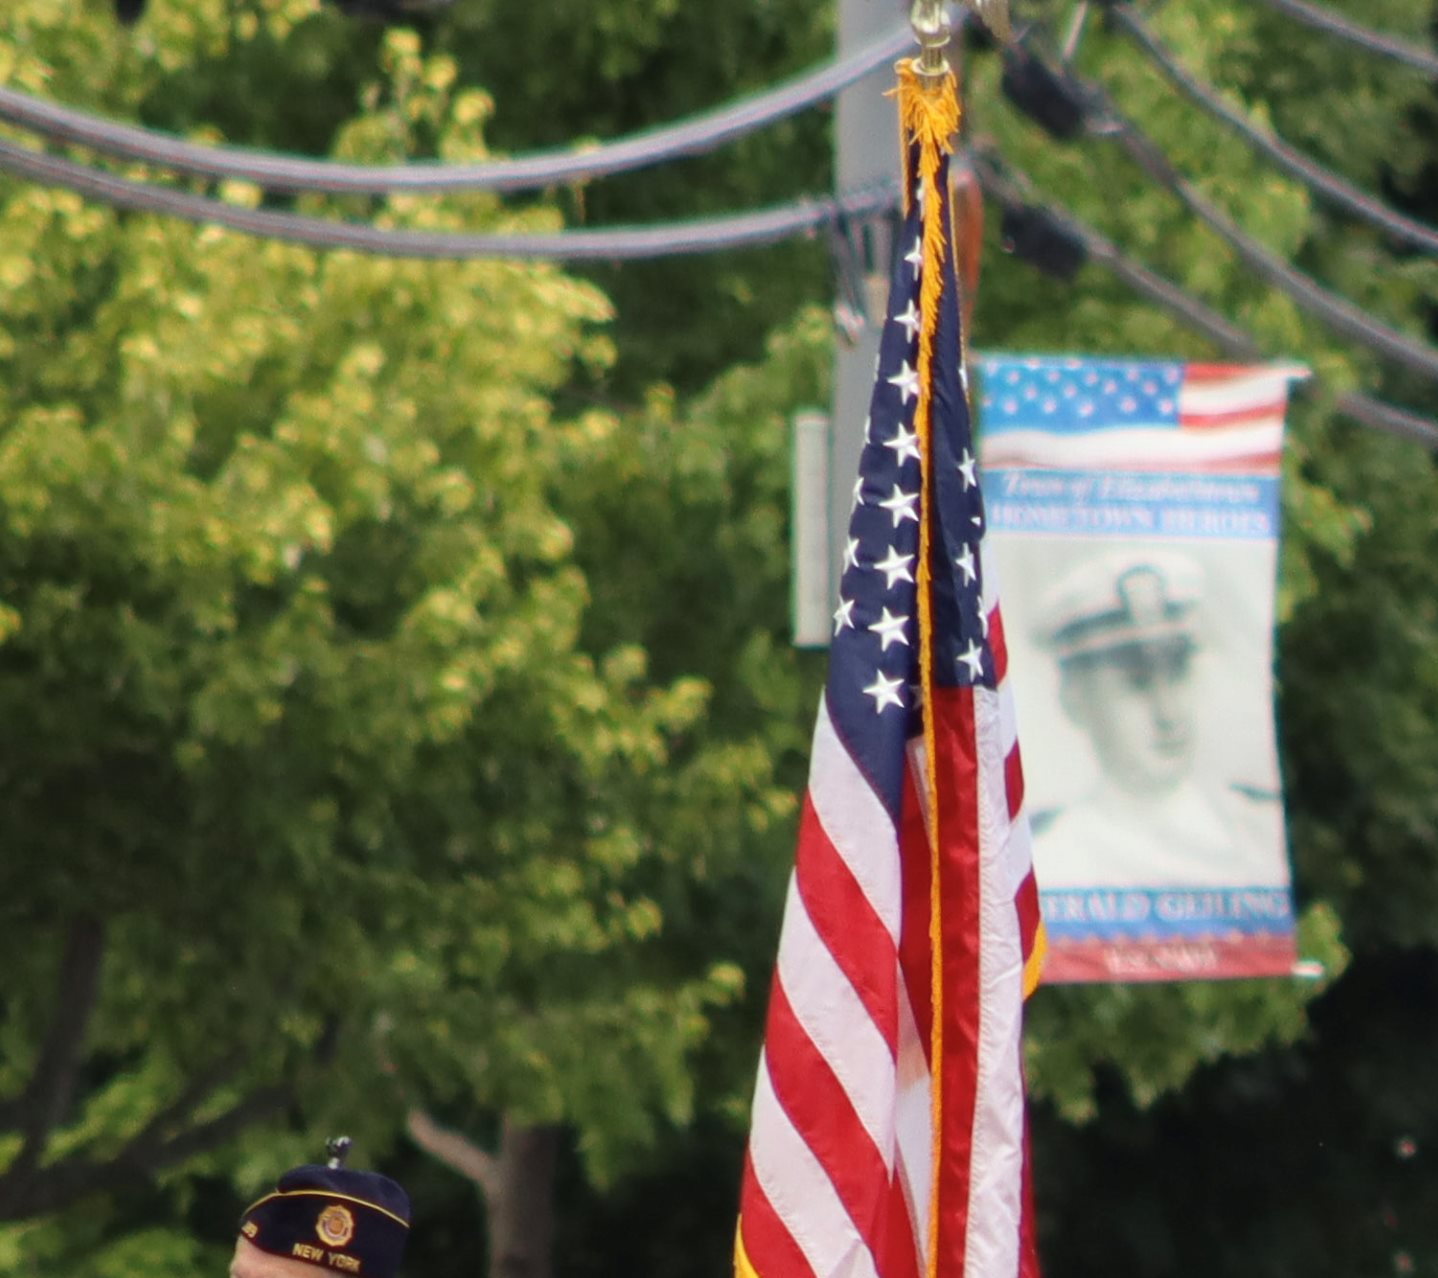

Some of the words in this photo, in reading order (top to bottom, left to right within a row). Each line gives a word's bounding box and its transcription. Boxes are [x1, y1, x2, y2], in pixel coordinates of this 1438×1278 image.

[1042, 893, 1149, 922] ERALD
[292, 1242, 325, 1262] NEW
[328, 1251, 362, 1273] YORK
